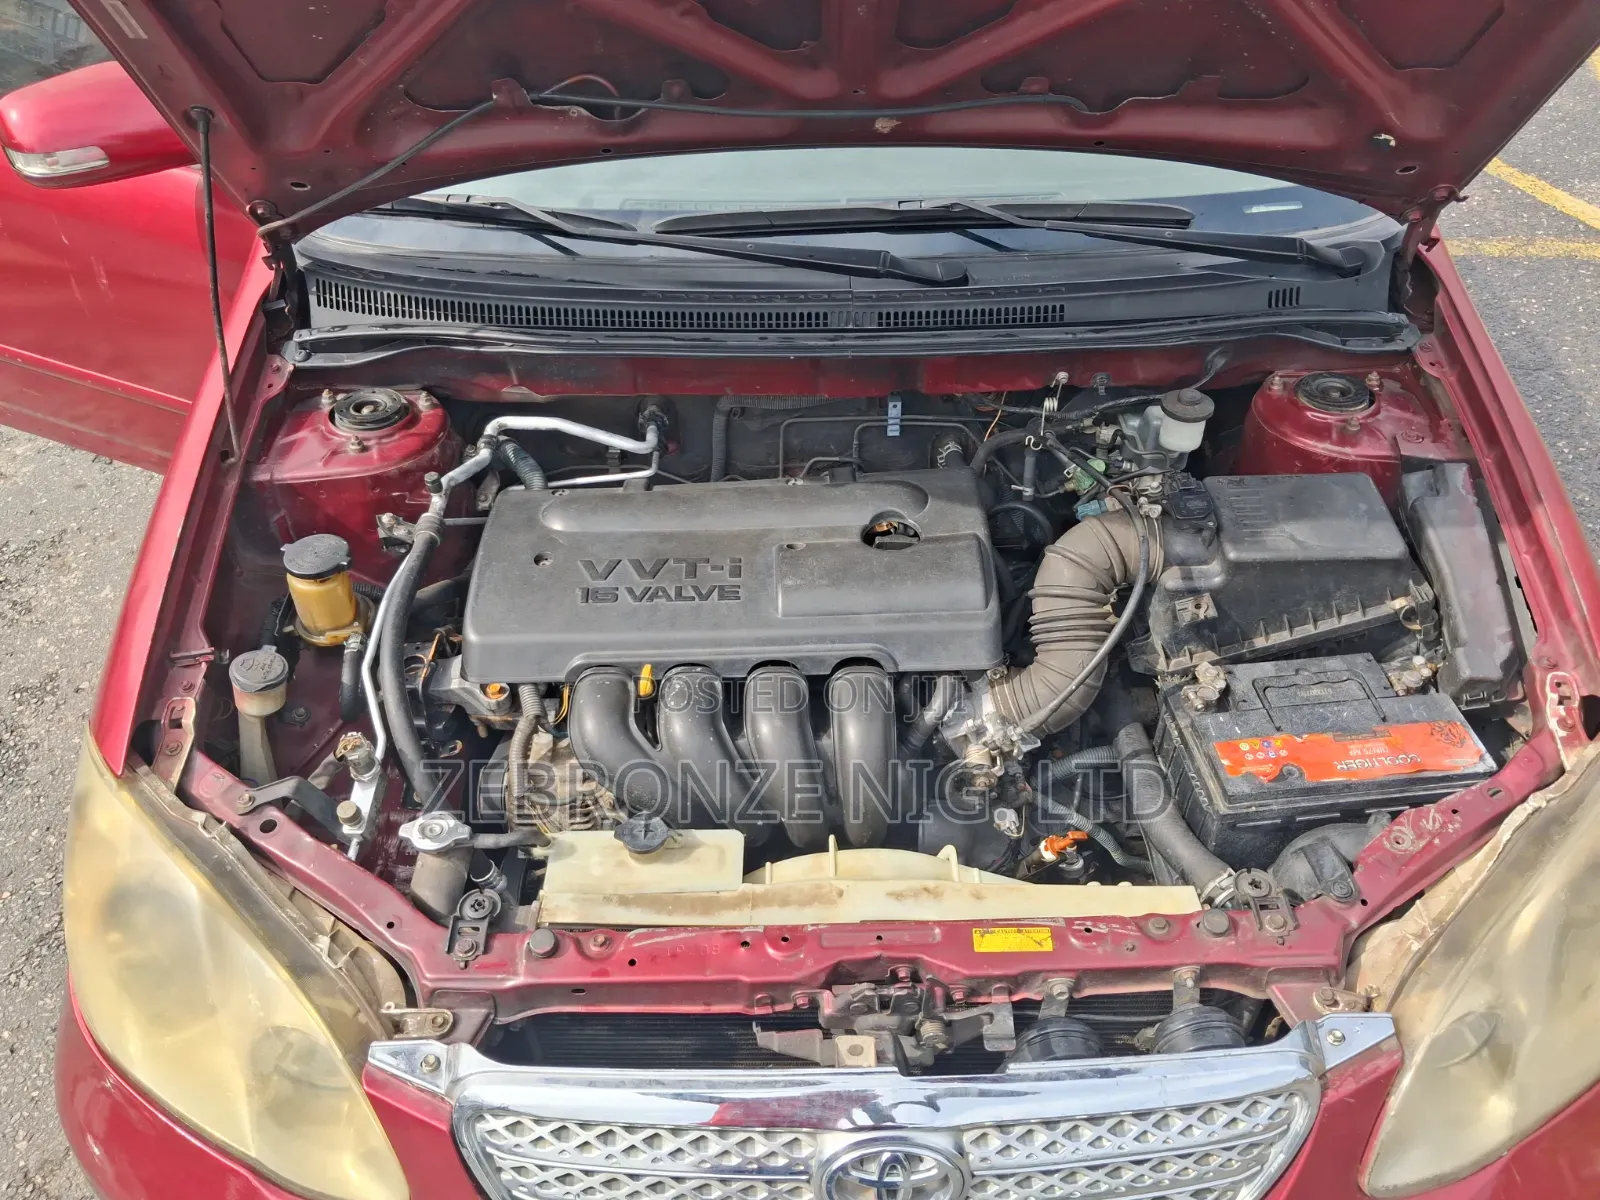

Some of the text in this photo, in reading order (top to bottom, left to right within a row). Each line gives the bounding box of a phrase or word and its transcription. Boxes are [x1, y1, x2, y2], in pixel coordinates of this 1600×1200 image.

[578, 557, 742, 581] VVT-i
[577, 584, 741, 604] 16 VALVE
[1334, 755, 1421, 771] COOLTIGER
